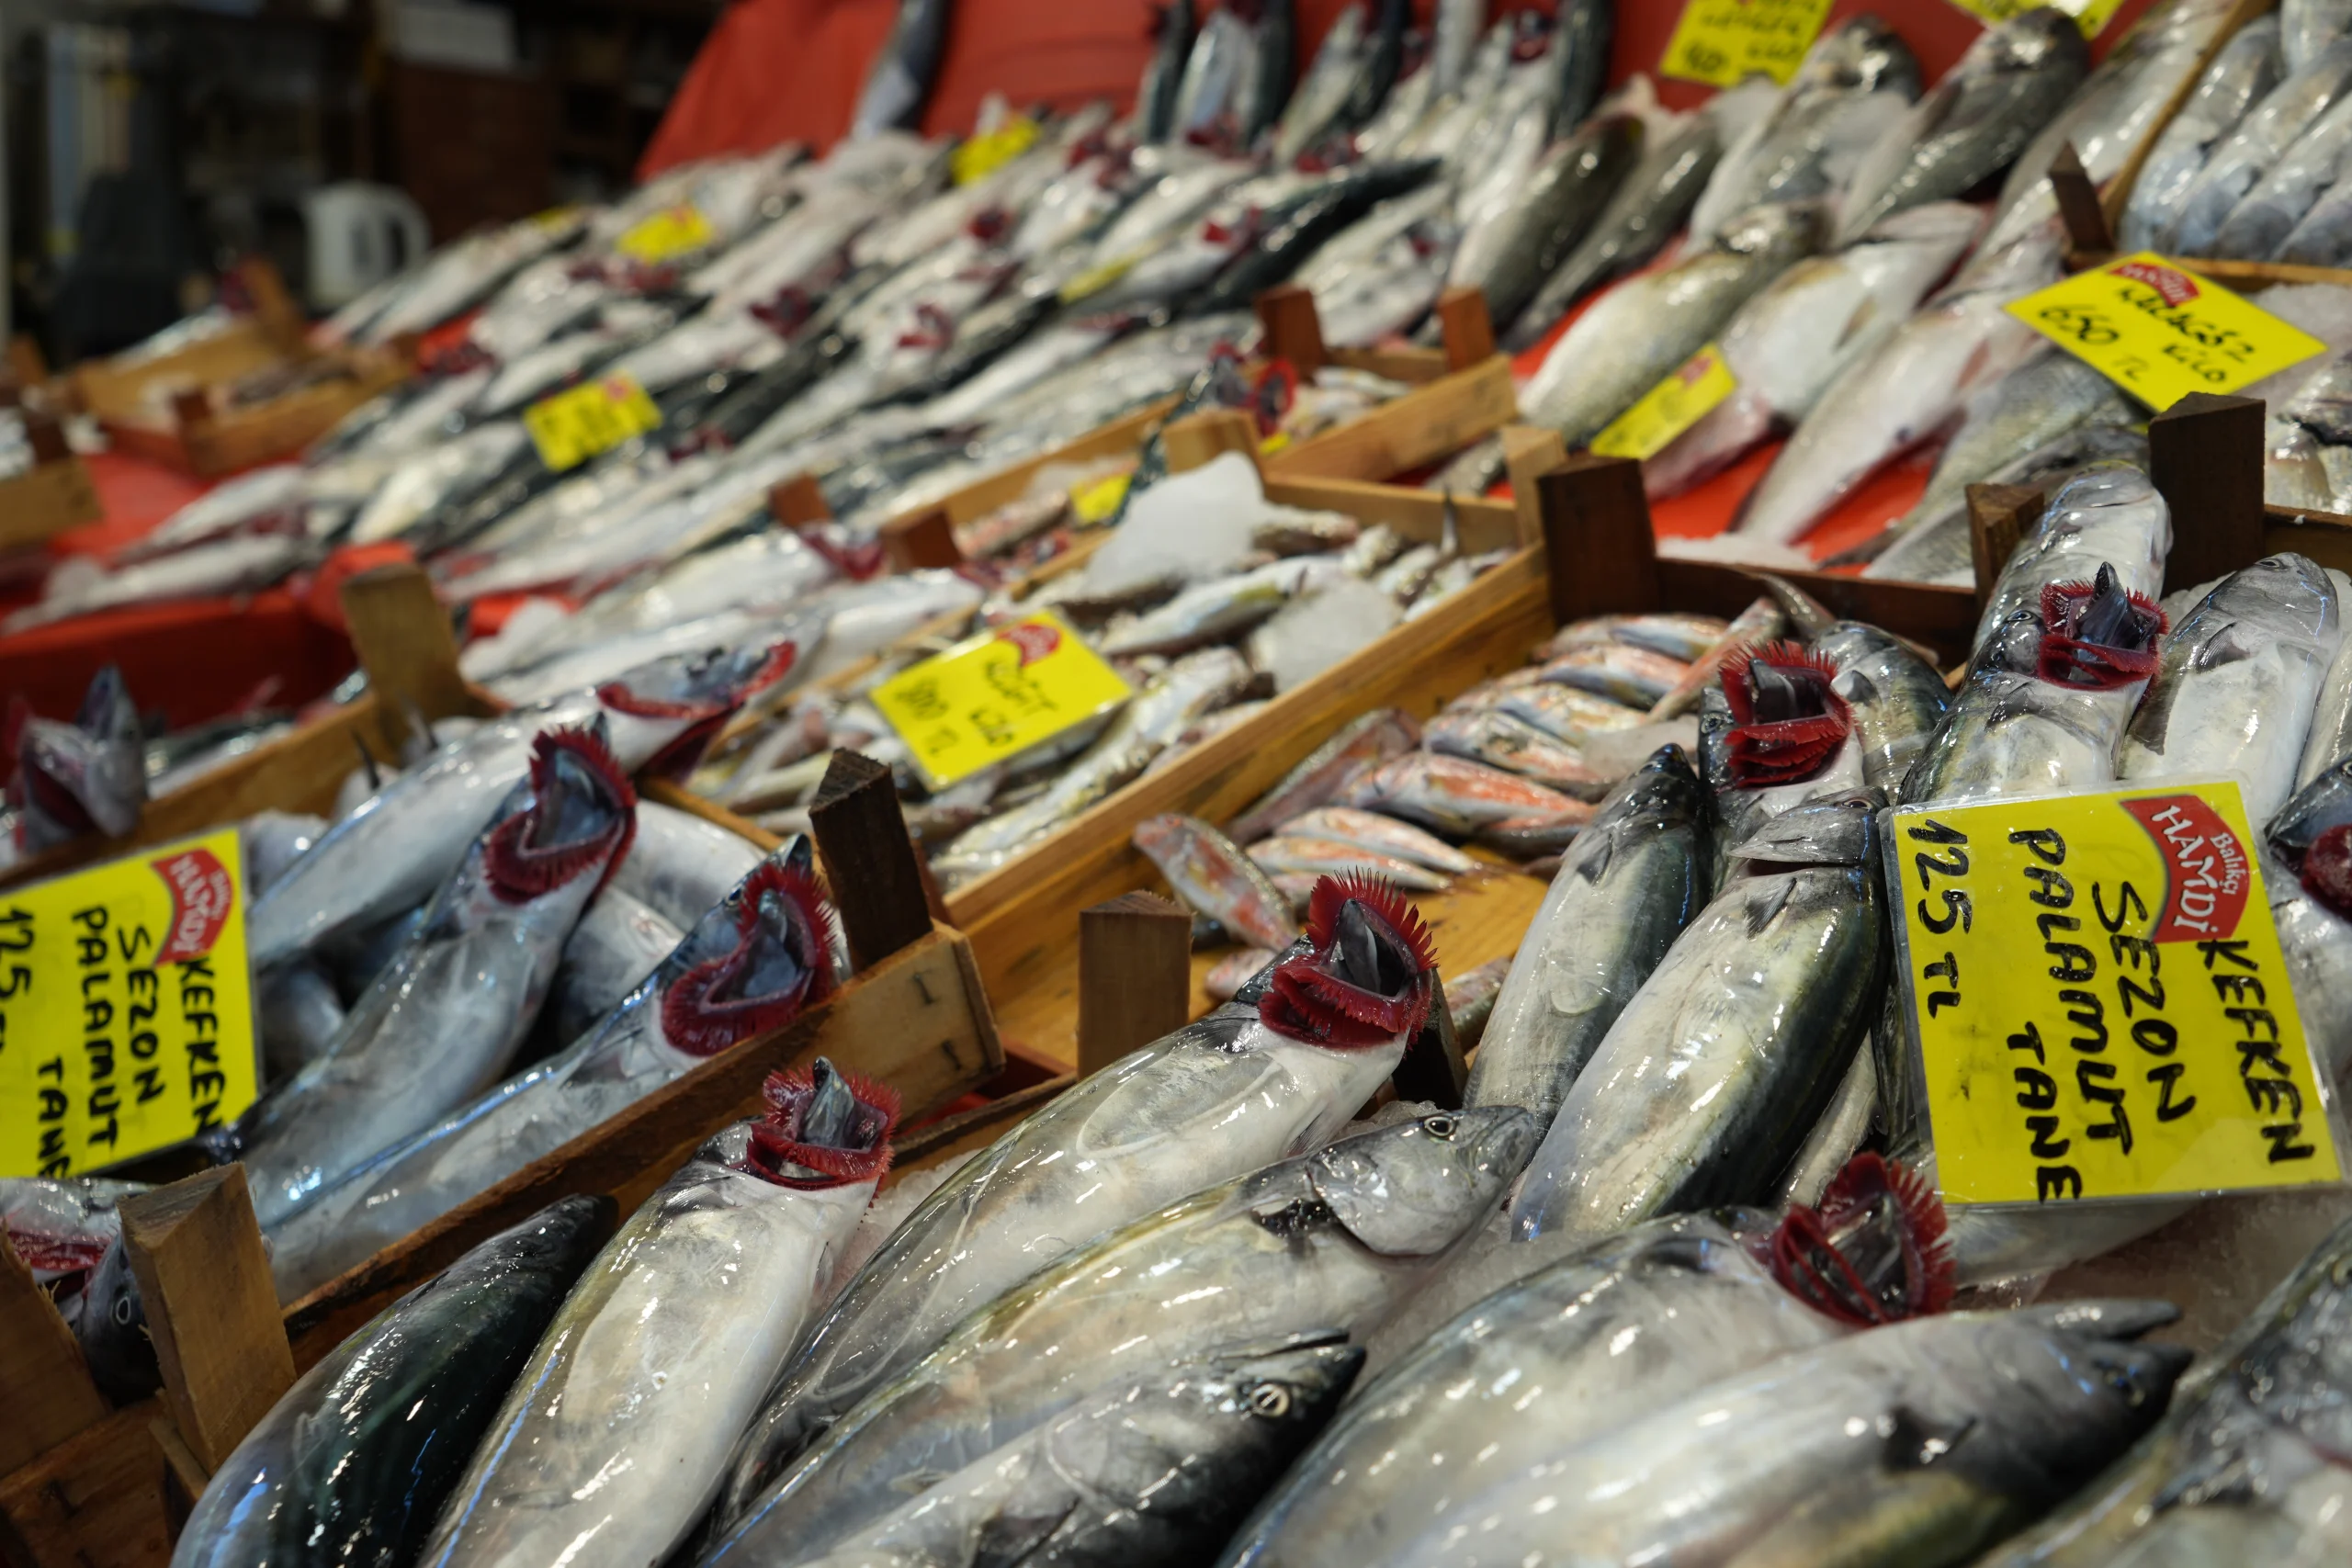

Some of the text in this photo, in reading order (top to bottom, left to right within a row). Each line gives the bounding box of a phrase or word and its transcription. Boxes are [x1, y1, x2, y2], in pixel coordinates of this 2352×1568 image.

[1907, 818, 1973, 935] 125
[2151, 805, 2219, 933] HAMDİ
[2210, 831, 2247, 896] Balıkçı
[72, 905, 121, 1150] PALAMUT
[118, 923, 166, 1105] SEZON
[175, 957, 227, 1136] KEFKEN
[2007, 828, 2133, 1156] PALAMUT
[2092, 881, 2197, 1123] SEZON
[2196, 939, 2316, 1165] KEFKEN
[2007, 1021, 2083, 1204] TANE
